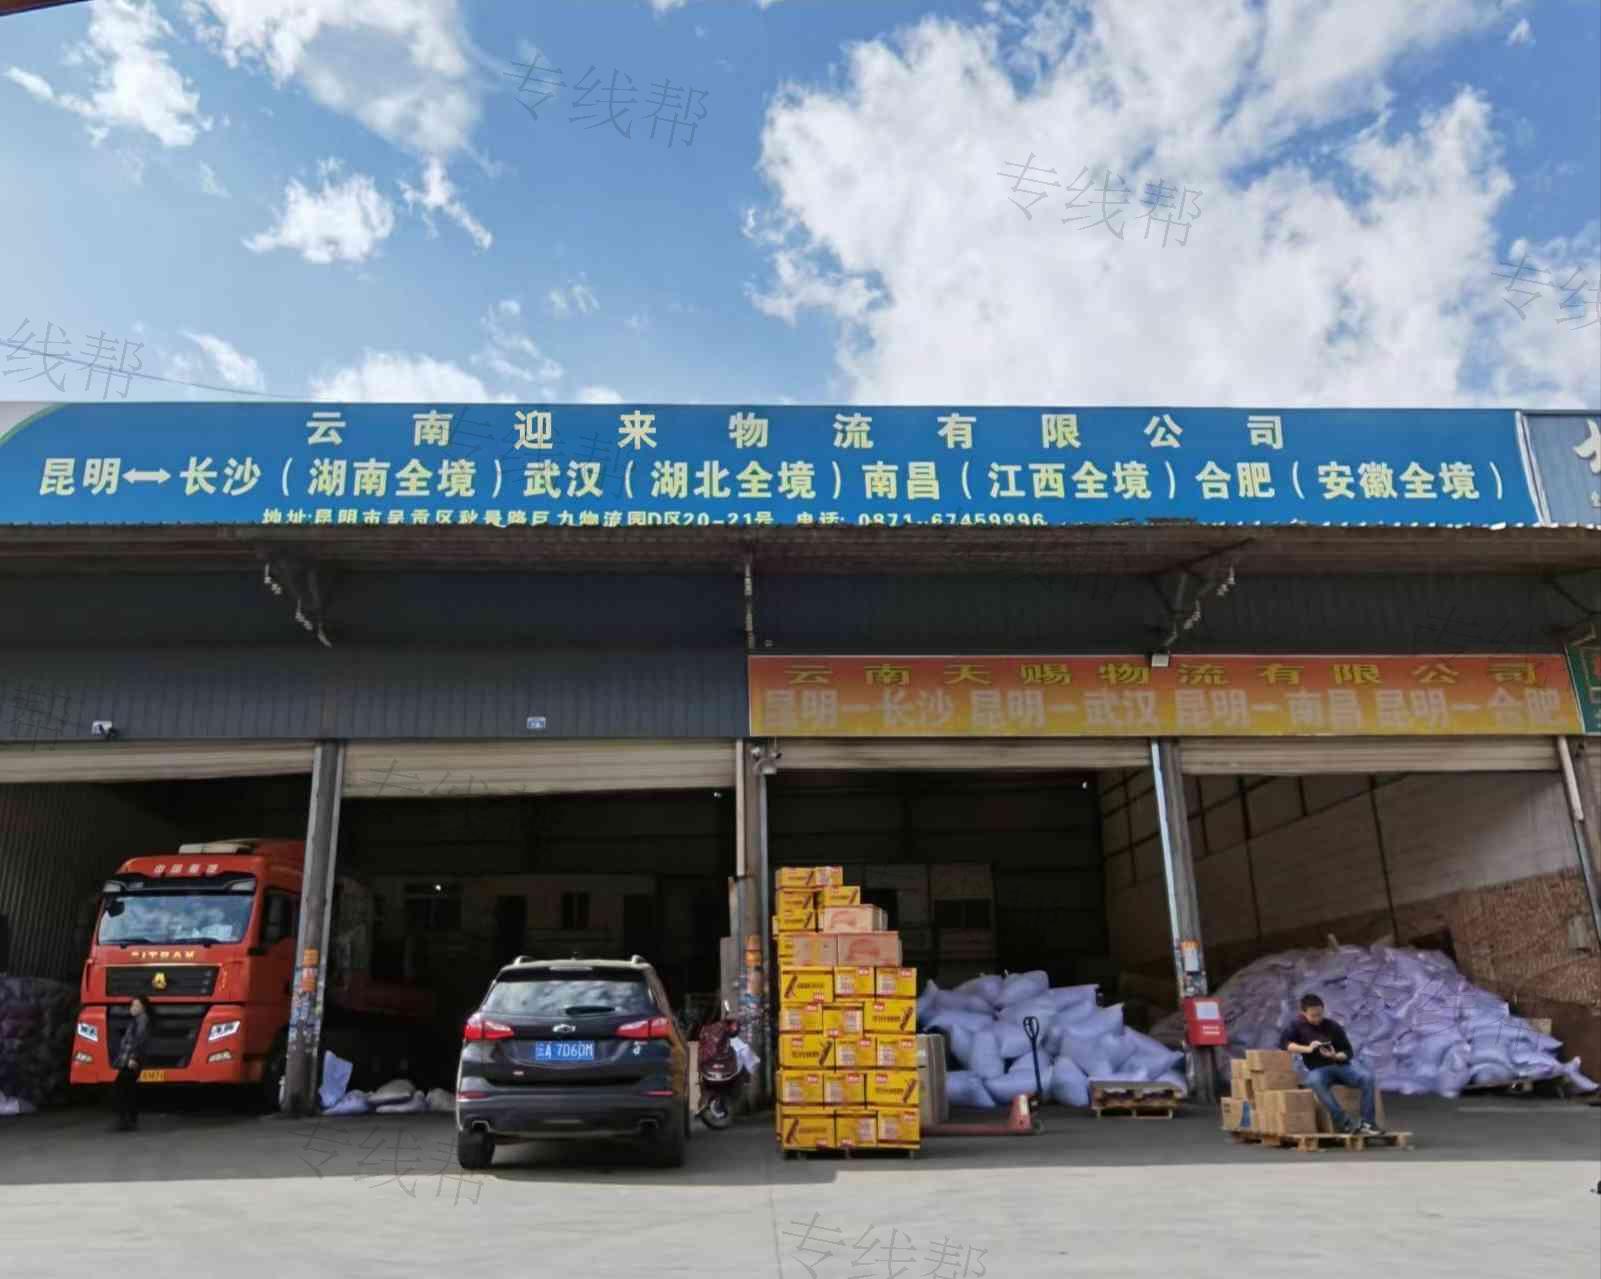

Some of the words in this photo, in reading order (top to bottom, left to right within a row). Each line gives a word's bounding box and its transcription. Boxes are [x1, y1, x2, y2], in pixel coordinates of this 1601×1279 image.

[306, 409, 1283, 451] 云南迎来物流有限公司
[785, 662, 1536, 686] 云南天赐物流有限公司
